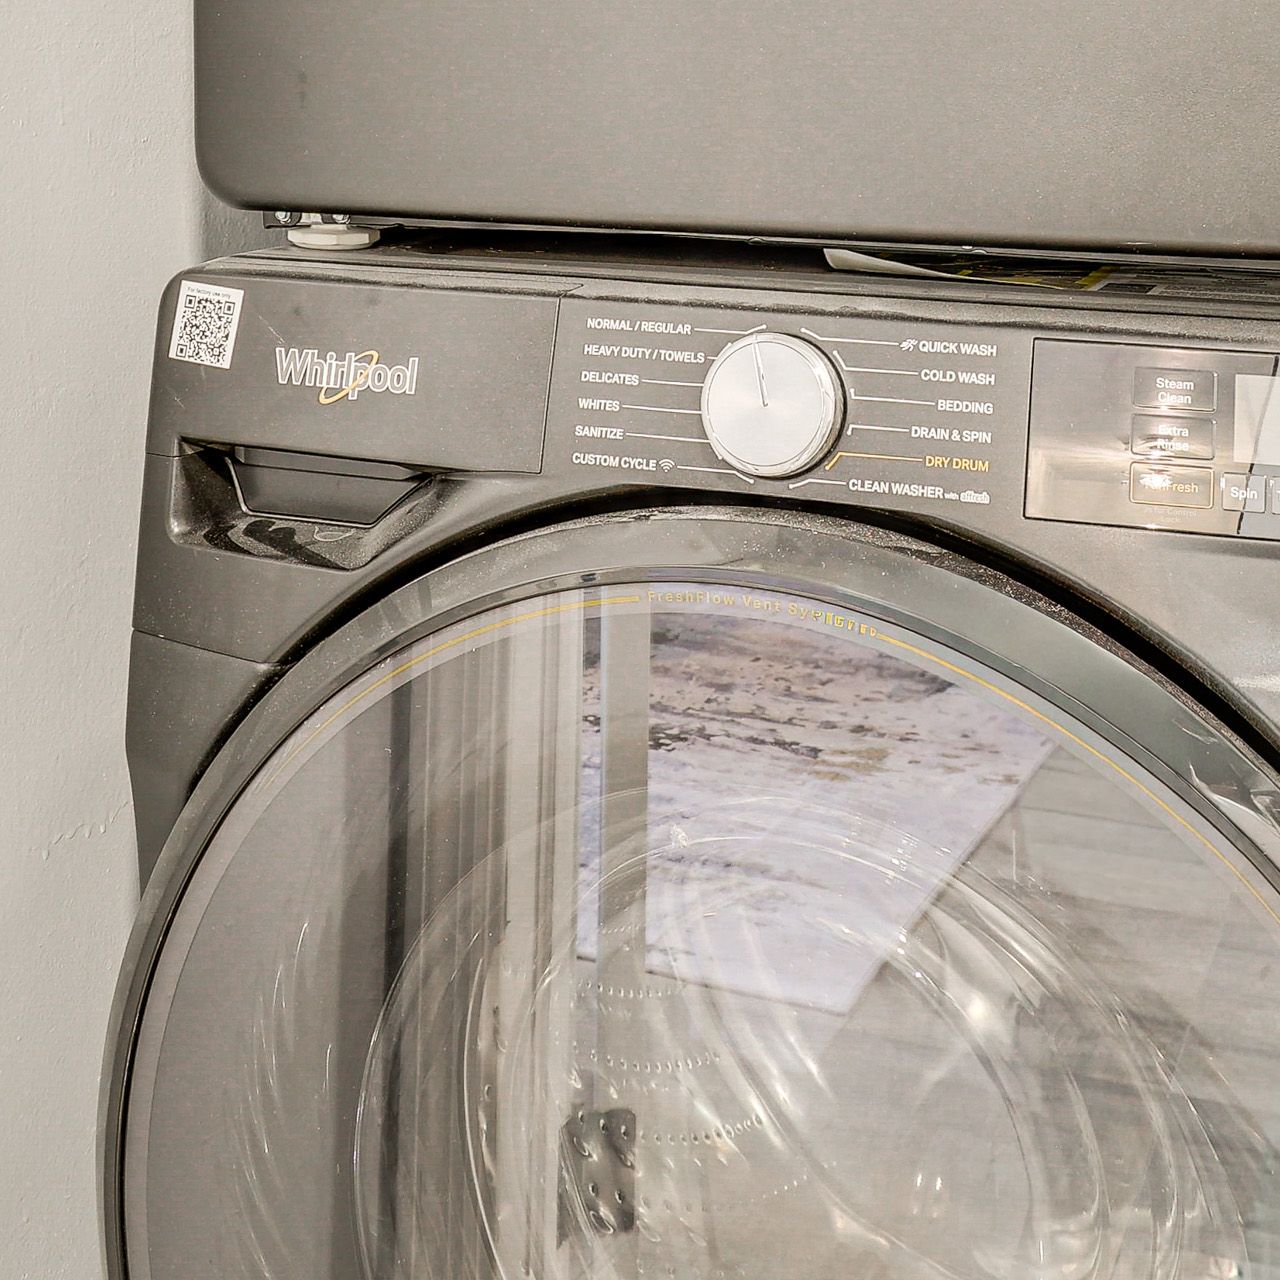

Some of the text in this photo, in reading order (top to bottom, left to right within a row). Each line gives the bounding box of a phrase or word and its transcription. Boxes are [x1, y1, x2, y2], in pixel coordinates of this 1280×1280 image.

[587, 318, 632, 331] NORMAL
[641, 322, 691, 335] REGULAR
[584, 345, 619, 357] HEAVY
[621, 347, 651, 360] DUTY
[659, 350, 704, 363] TOWELS
[919, 341, 997, 356] QUICK WASH
[275, 346, 418, 400] Whirlpool
[581, 371, 639, 386] DELICATES
[920, 369, 995, 385] COLD WASH
[1156, 378, 1194, 390] Steam
[578, 398, 619, 411] WHITES
[1158, 392, 1192, 404] Clean
[937, 400, 994, 414] BEDDING
[575, 426, 623, 440] SANITIZE
[911, 426, 991, 443] DRAIN & SPIN
[1158, 426, 1189, 437] Extra
[1157, 439, 1189, 452] Rinse
[572, 453, 656, 471] CUSTOM CYCLE
[925, 456, 989, 472] DRY DRUM
[848, 479, 889, 494] CLEAN
[890, 482, 943, 499] WASHER
[944, 492, 959, 500] with
[1231, 487, 1257, 500] Spin
[648, 591, 780, 613] FreshFlow Vent
